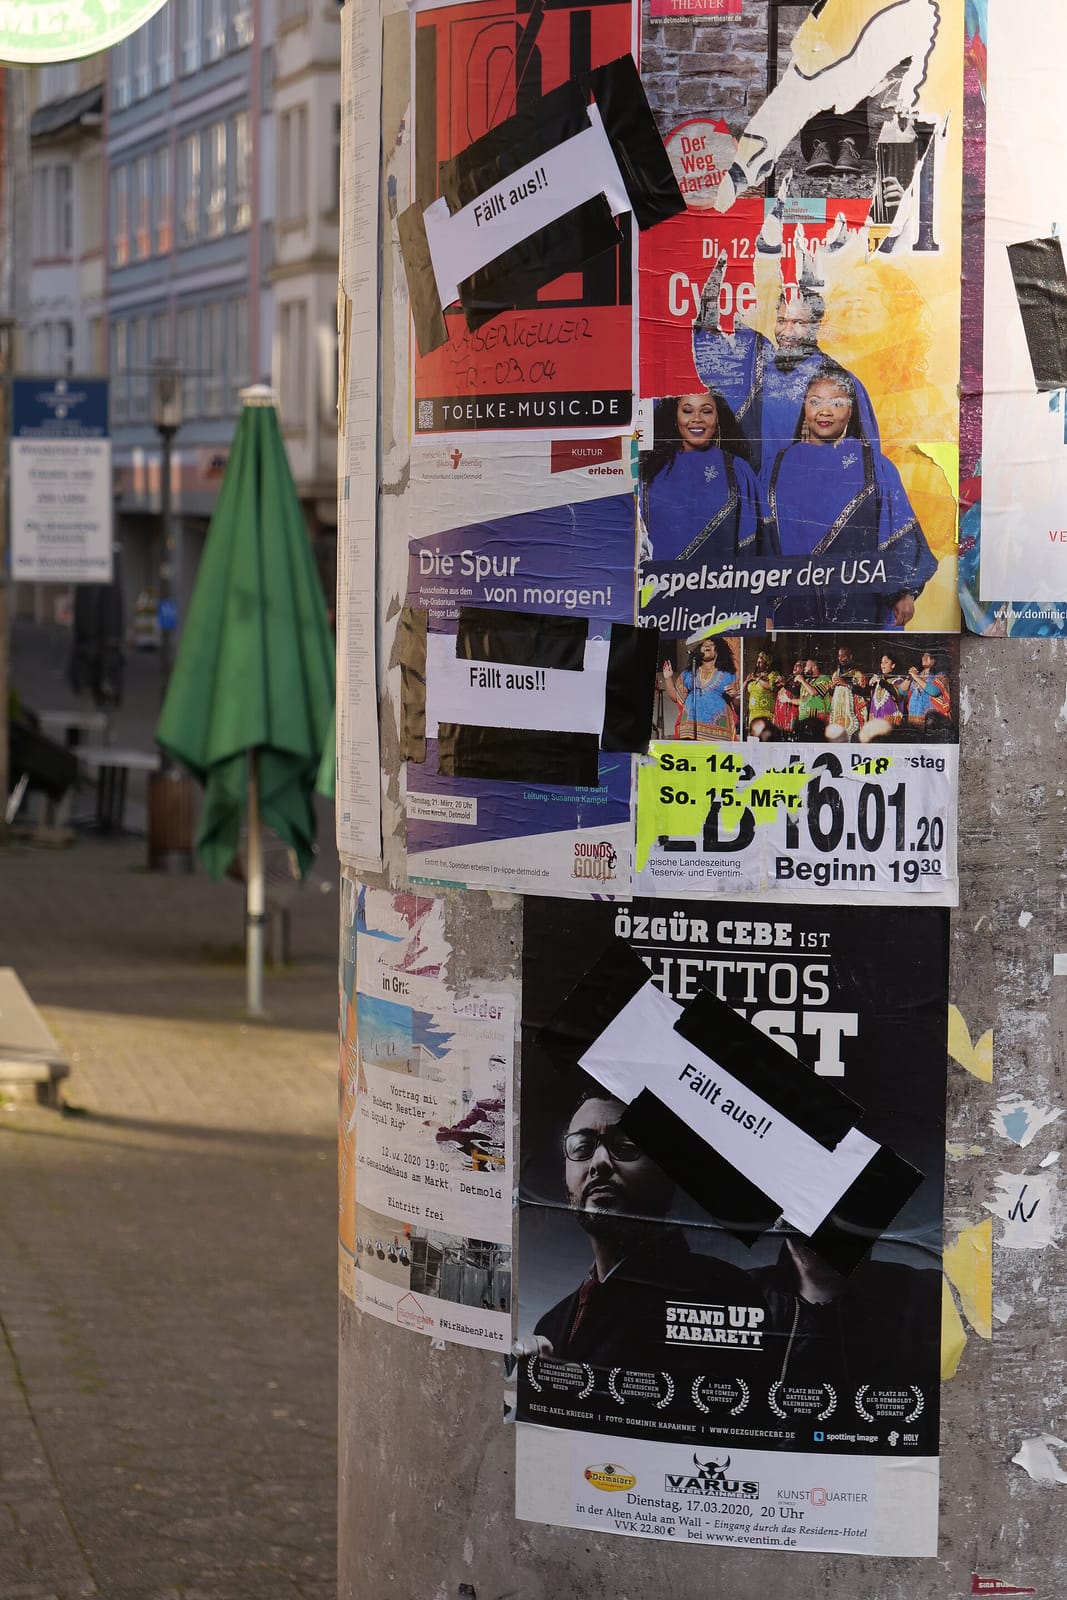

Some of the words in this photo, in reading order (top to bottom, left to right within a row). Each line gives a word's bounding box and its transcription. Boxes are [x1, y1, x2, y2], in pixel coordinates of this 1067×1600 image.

[671, 0, 724, 10] THEATER
[680, 134, 707, 155] Der
[680, 153, 714, 175] Weg
[473, 194, 507, 227] Fällt
[508, 167, 549, 207] aus!!
[731, 238, 755, 259] 12.
[442, 399, 620, 422] TOELKE-MUSIC.DE
[571, 448, 604, 457] KULTUR
[588, 465, 624, 476] erleben
[419, 548, 454, 576] Die
[460, 550, 521, 583] Spur
[797, 561, 835, 587] der
[840, 559, 887, 585] USA
[460, 586, 473, 597] dem
[484, 588, 517, 604] von
[523, 586, 612, 610] morgen!
[470, 667, 502, 689] Fällt
[506, 671, 546, 691] aus!!
[660, 753, 697, 773] Sa.
[706, 753, 741, 773] 14.
[463, 801, 473, 809] Uhr
[523, 791, 550, 803] Leitung:
[551, 793, 580, 803] Susanna
[660, 787, 697, 806] So.
[449, 810, 471, 820] Detmold
[574, 842, 612, 858] SOUNDS
[448, 861, 471, 872] Spenden
[471, 864, 490, 873] erbeten
[646, 857, 678, 870] pische
[679, 857, 741, 870] Landeszeitung
[687, 868, 704, 878] und
[706, 868, 744, 878] Eventim-
[775, 857, 876, 887] Beginn
[614, 908, 709, 944] ÖZGÜR
[716, 920, 793, 948] CEBE
[799, 932, 831, 948] IST
[382, 974, 390, 991] in
[641, 955, 830, 1006] HETTOS
[390, 1085, 420, 1104] Vortrag
[423, 1094, 438, 1106] mit
[678, 1062, 722, 1106] Fällt
[721, 1097, 773, 1140] aus!!
[372, 1095, 393, 1111] Robert
[396, 1103, 426, 1119] Nestler
[411, 1173, 422, 1183] am
[460, 1182, 502, 1200] Detmold
[387, 1196, 420, 1216] Eintritt
[425, 1209, 445, 1222] frei
[666, 1306, 725, 1327] STAND
[728, 1305, 765, 1329] UP
[439, 1318, 504, 1342] #WirHabenPlatz
[665, 1326, 764, 1346] KABARETT
[706, 1395, 733, 1403] CONTEST
[715, 1389, 739, 1397] COMEDY
[782, 1400, 823, 1408] KLEINKUNST-
[549, 1406, 565, 1416] AXEL
[566, 1410, 594, 1420] KRIEGER
[605, 1414, 625, 1424] FOTO:
[626, 1417, 657, 1428] DOMINIK
[658, 1420, 697, 1431] KAPAHNKE
[709, 1426, 796, 1439] WWW.OEZGUERCEBE.DE
[826, 1433, 856, 1443] spotting
[857, 1433, 879, 1443] image
[903, 1433, 920, 1441] HOLY
[666, 1474, 759, 1494] VARUS
[627, 1493, 683, 1513] Dienstag,
[687, 1499, 754, 1518] 17.03.2020,
[760, 1505, 776, 1519] 20
[779, 1506, 805, 1520] Uhr
[777, 1487, 868, 1507] KUNSTQUARTIER
[576, 1503, 586, 1513] in
[588, 1504, 604, 1516] der
[606, 1507, 633, 1520] Alten
[634, 1511, 658, 1523] Aula
[660, 1516, 676, 1525] am
[678, 1515, 702, 1528] Wall
[714, 1519, 751, 1533] Eingang
[752, 1521, 779, 1534] durch
[781, 1525, 797, 1535] das
[799, 1525, 868, 1538] Residenz-Hotel
[614, 1519, 638, 1532] VVK
[640, 1523, 666, 1536] 22.80
[687, 1529, 703, 1540] bei
[706, 1531, 798, 1548] www.eventim.de
